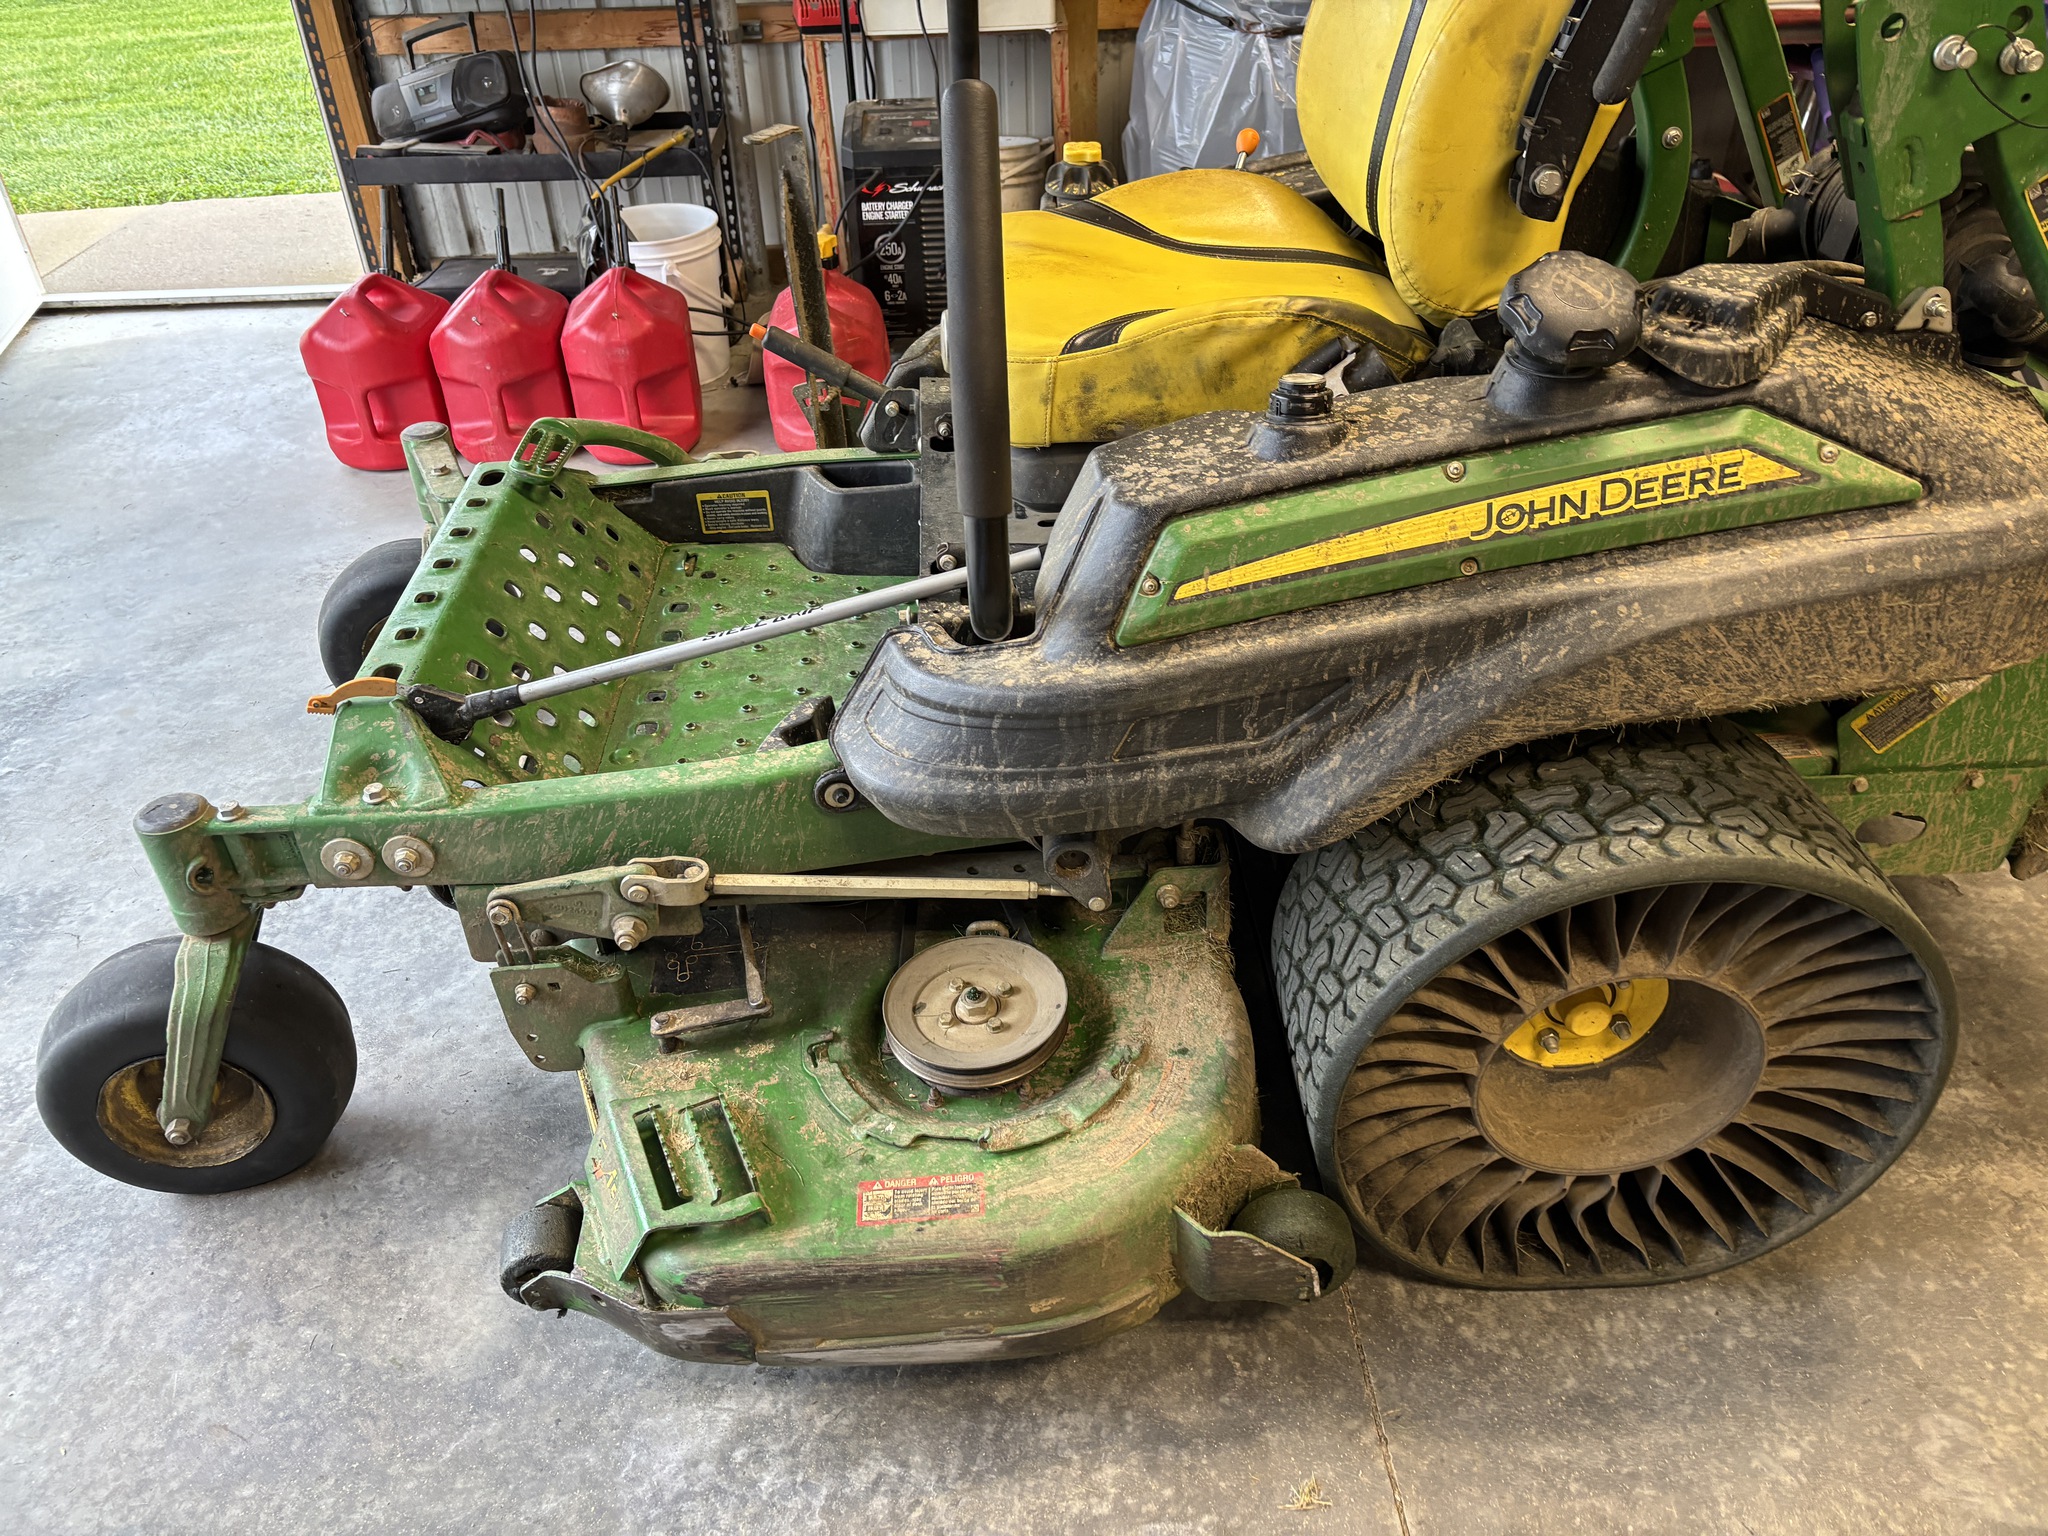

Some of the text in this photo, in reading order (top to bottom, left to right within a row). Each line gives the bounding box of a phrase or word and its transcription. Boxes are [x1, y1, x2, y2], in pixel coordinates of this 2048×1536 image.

[861, 201, 885, 211] BATTERY
[862, 211, 884, 220] ENGINE
[1471, 460, 1744, 537] JOHN DEERE
[884, 1174, 975, 1188] DANGER PELIGRO
